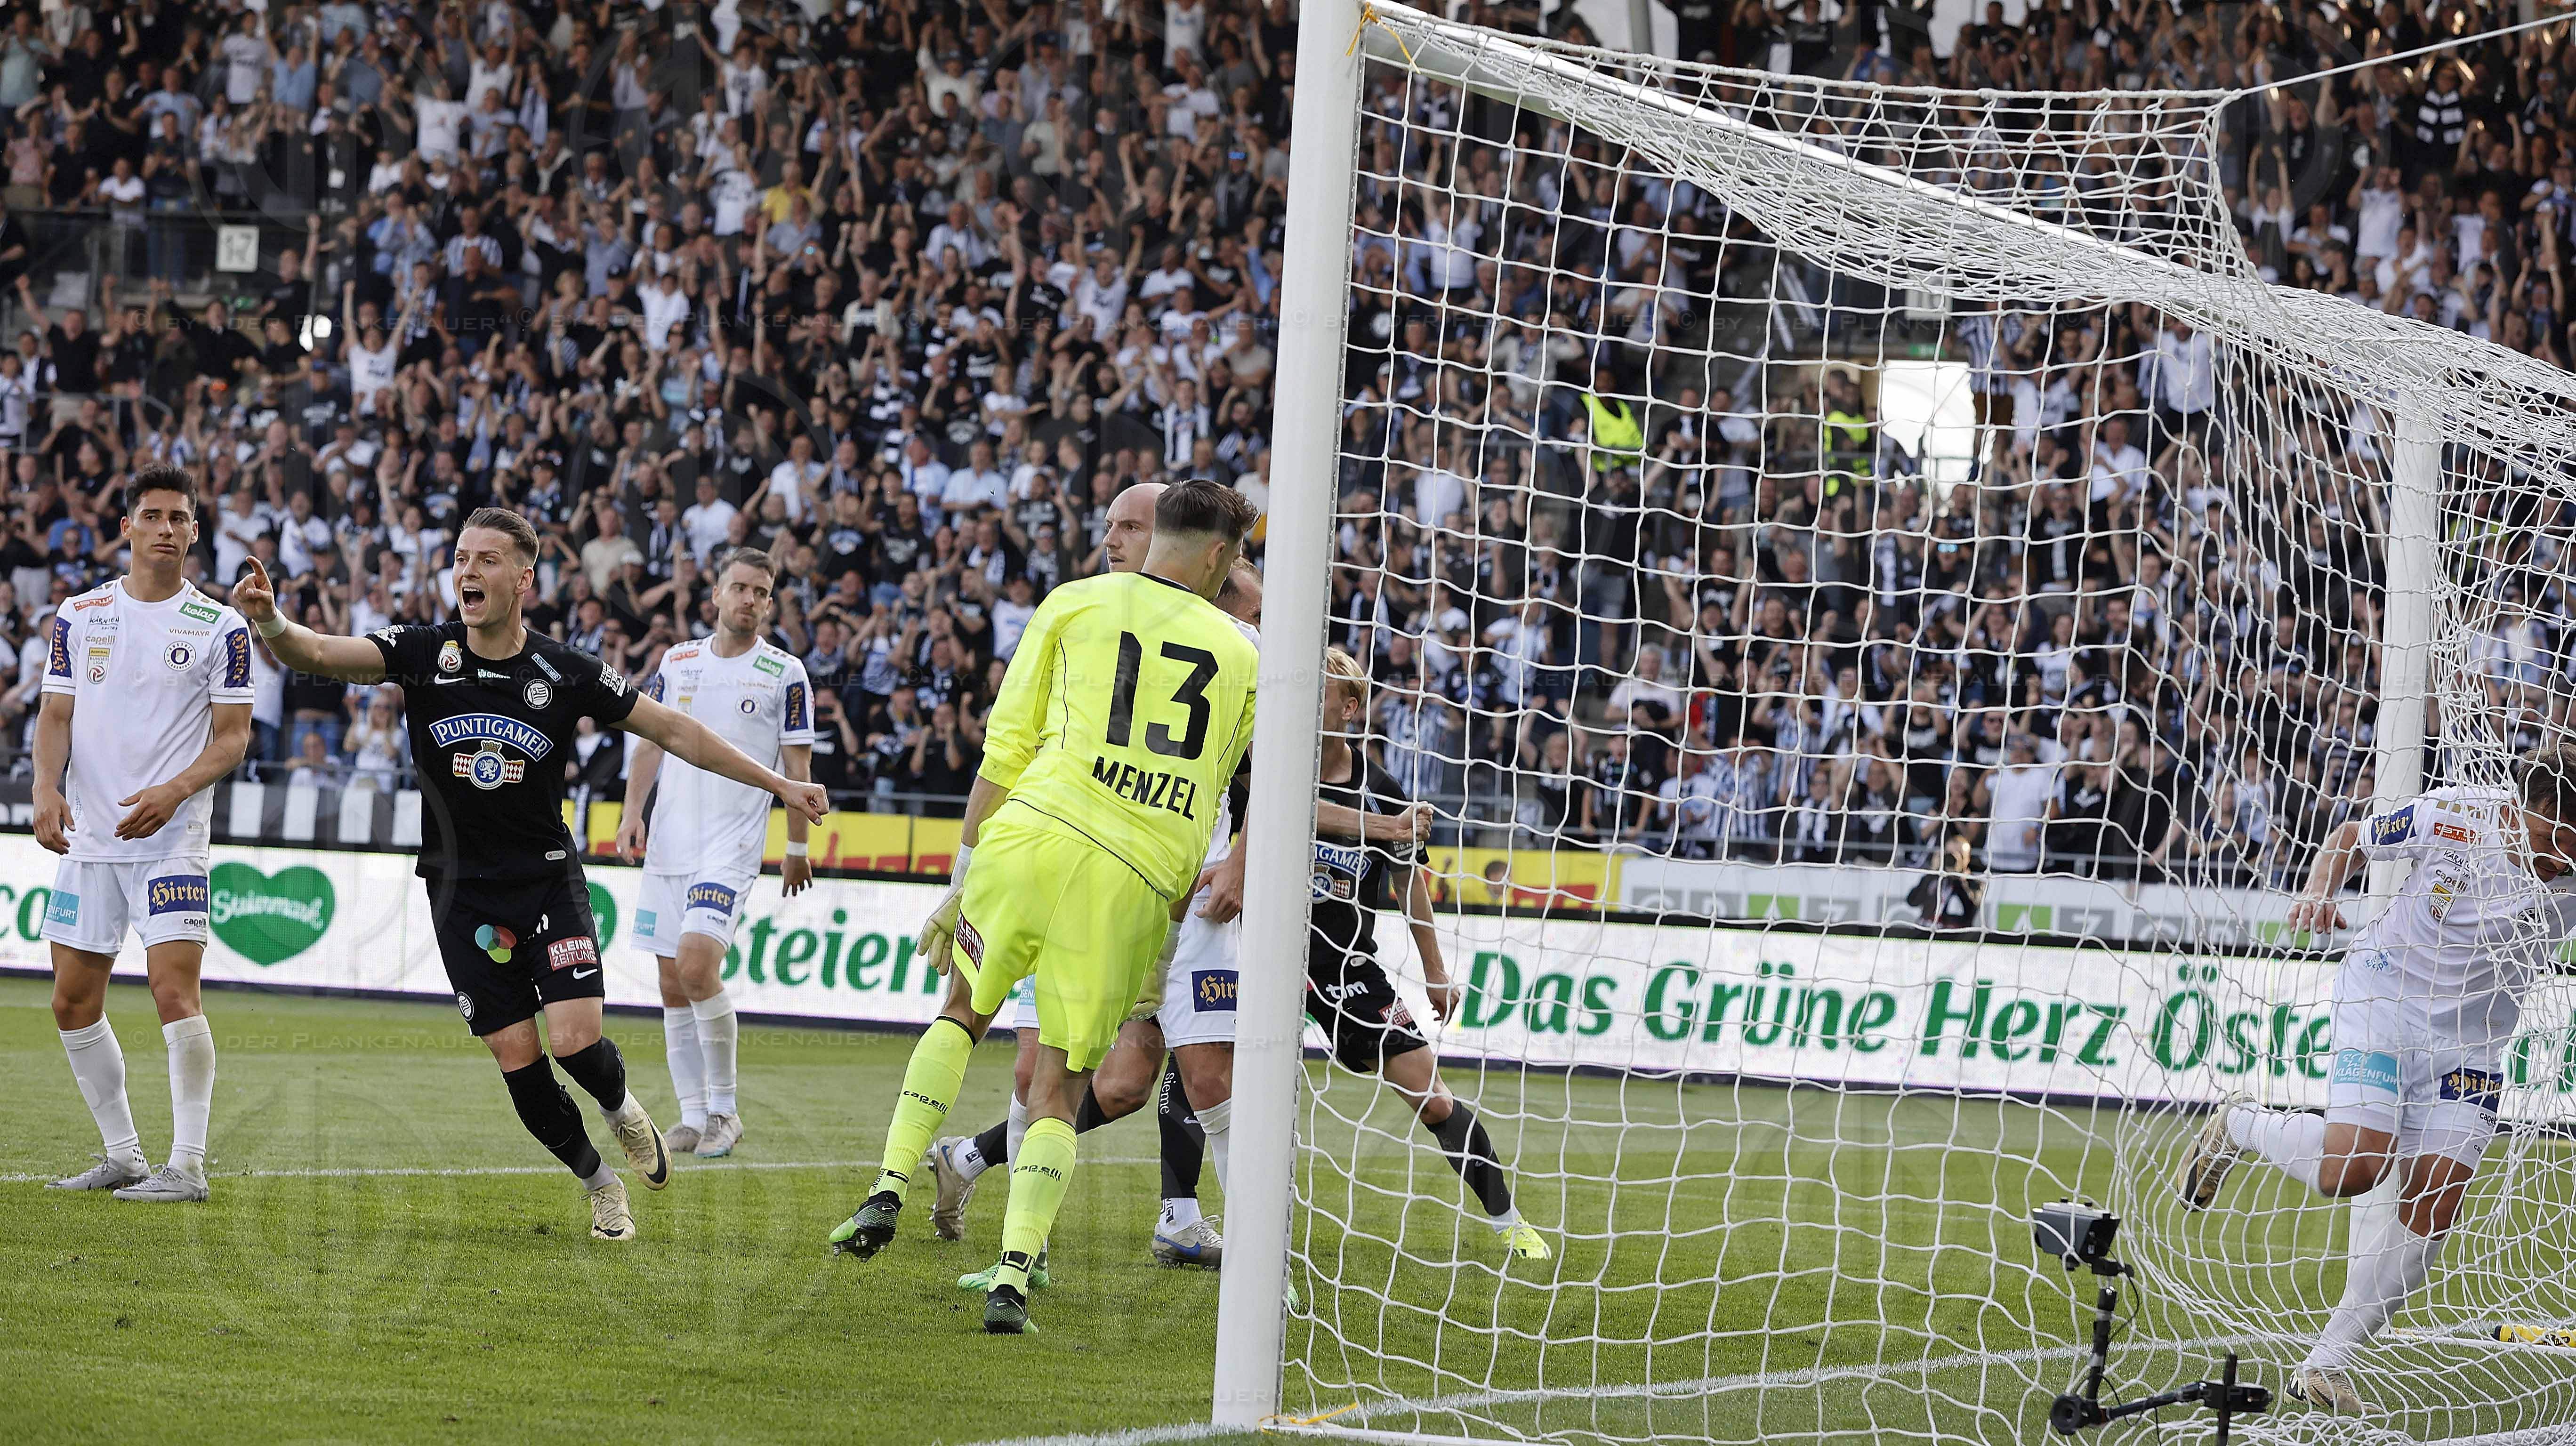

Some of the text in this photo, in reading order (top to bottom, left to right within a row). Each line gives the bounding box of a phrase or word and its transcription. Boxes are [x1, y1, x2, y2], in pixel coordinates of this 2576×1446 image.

[183, 603, 216, 621] kelag
[169, 628, 210, 636] VIVAMAYR
[1106, 631, 1218, 760] 13
[435, 718, 548, 756] PUNTIGAMER
[1092, 756, 1196, 821] MENZEL
[152, 881, 206, 908] Hirter
[550, 940, 594, 956] KLEINE
[553, 952, 596, 967] ZEITUNG
[1462, 951, 1616, 1036] Das
[1643, 961, 1896, 1053] Grüne
[1920, 977, 2126, 1066] Herz
[2335, 1068, 2397, 1084] KLAGENFUR
[903, 1091, 948, 1113] capelli
[1014, 1165, 1062, 1180] capelli
